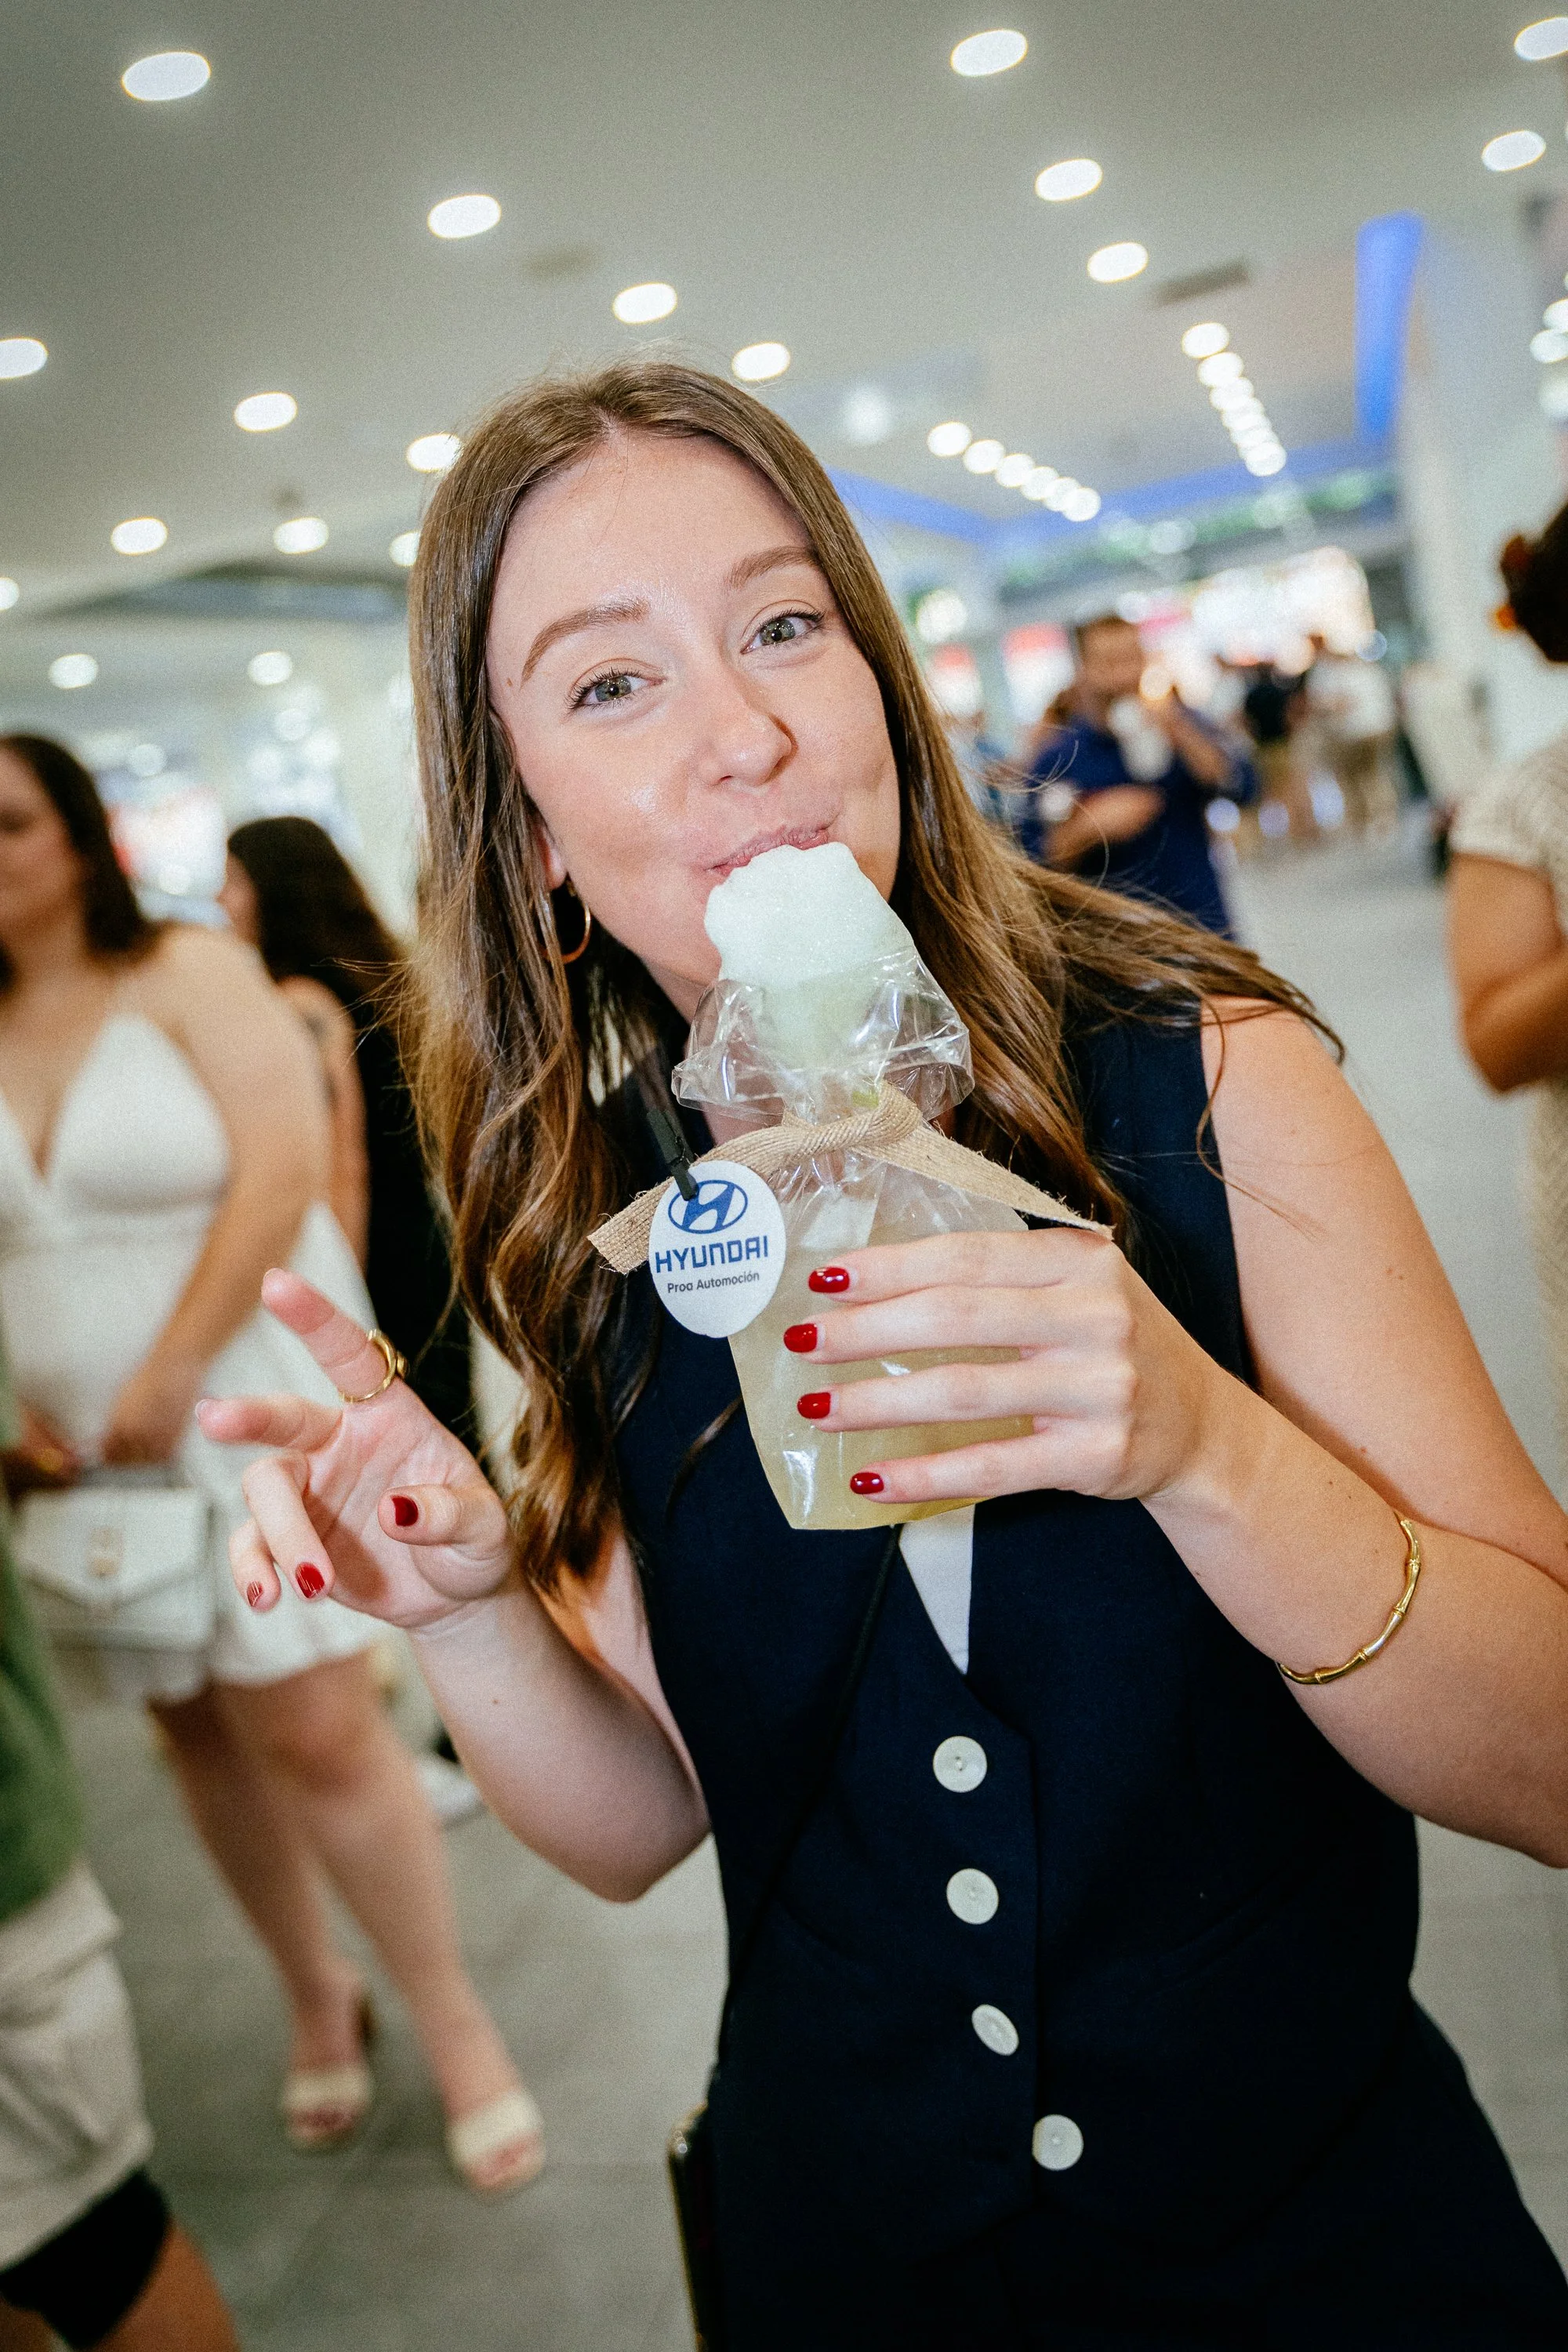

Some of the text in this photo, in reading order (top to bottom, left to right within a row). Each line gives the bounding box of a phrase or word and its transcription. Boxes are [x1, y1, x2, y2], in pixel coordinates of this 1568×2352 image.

[655, 1236, 769, 1273] HYUNDAI
[667, 1271, 760, 1293] Proa Automoción
